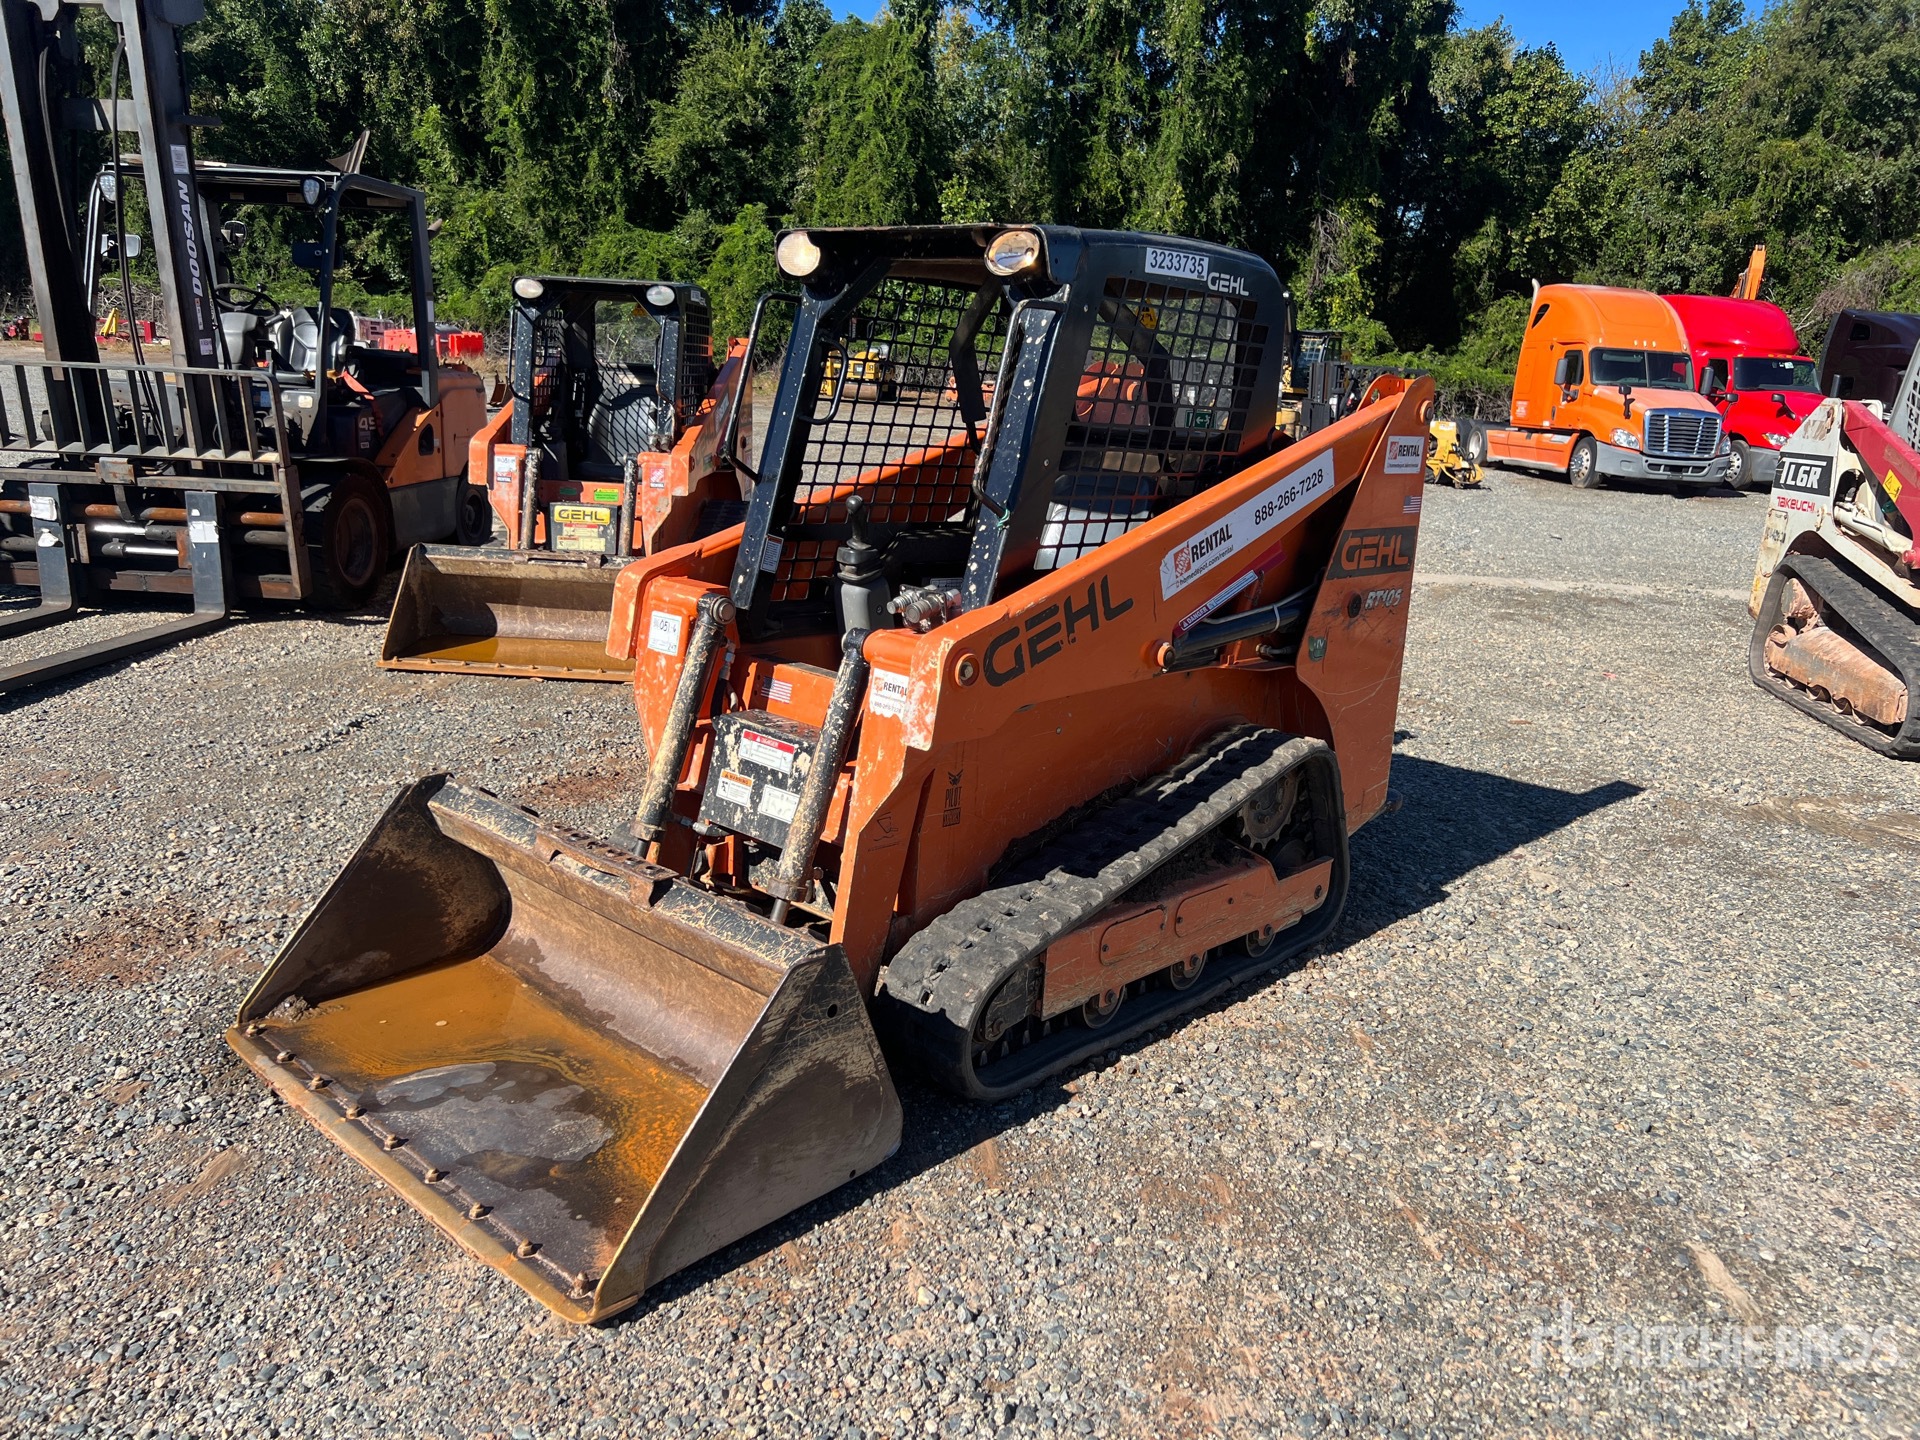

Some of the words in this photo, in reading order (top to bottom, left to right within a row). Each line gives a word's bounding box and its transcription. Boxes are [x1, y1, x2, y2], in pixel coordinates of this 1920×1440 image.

[177, 179, 203, 297] DOOSAN
[1150, 250, 1205, 276] 3233735
[1207, 272, 1250, 296] GEHL
[1398, 444, 1420, 457] RENTAL
[1779, 457, 1828, 489] TL6R
[558, 508, 605, 522] GEHL
[1191, 523, 1233, 564] RENTAL
[1254, 468, 1324, 527] 888-266-7228
[1341, 534, 1409, 571] GEHL
[1186, 605, 1209, 624] DANGER
[984, 574, 1134, 688] GEHL
[883, 681, 908, 696] RENTAL
